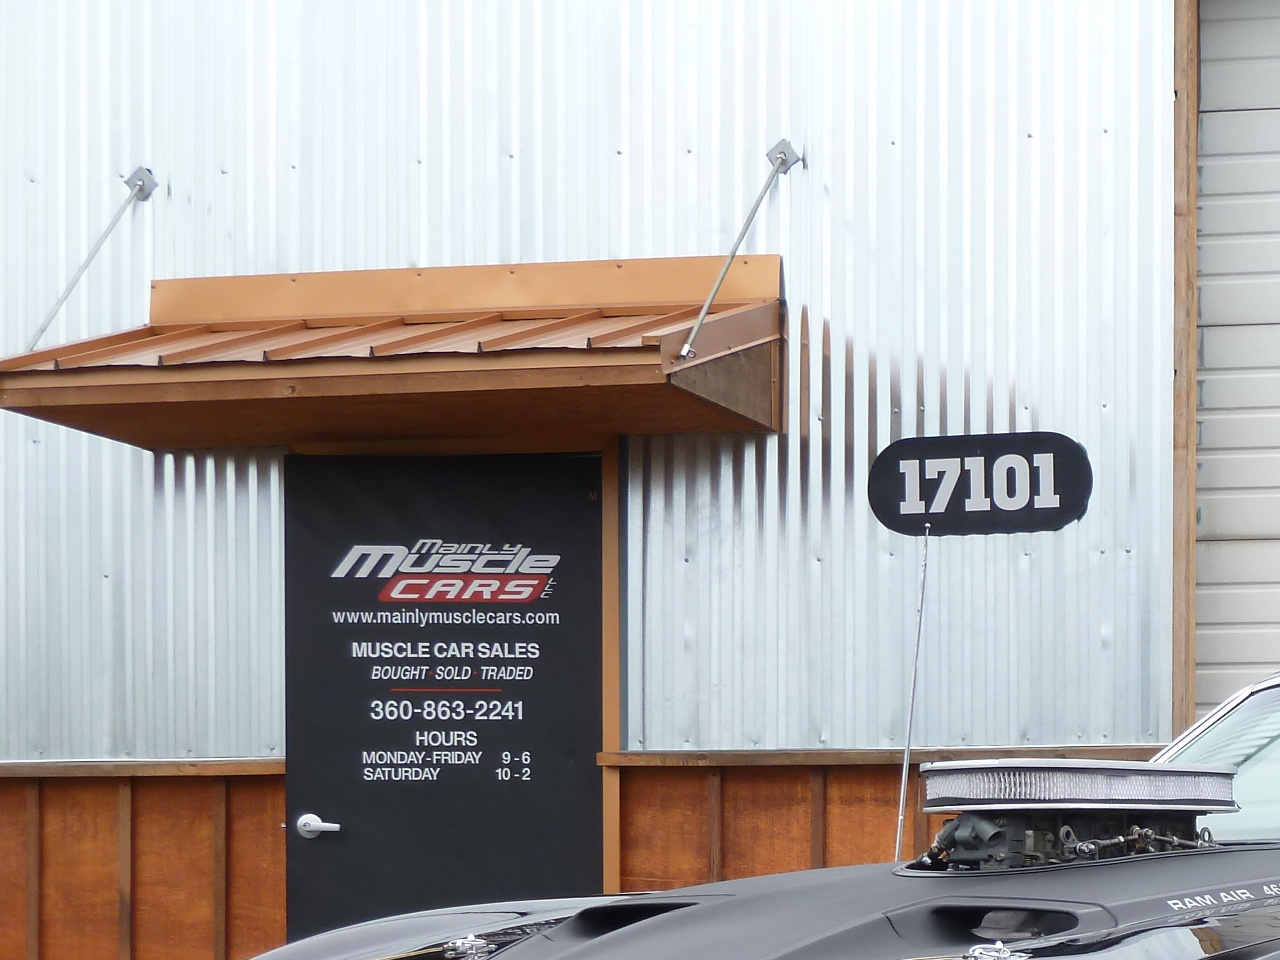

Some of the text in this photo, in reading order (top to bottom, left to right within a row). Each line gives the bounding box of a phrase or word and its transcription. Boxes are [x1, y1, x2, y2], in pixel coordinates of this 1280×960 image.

[899, 453, 1060, 514] 17101
[390, 579, 540, 599] CARS
[332, 608, 560, 627] www.mainlymusclecars.com
[351, 642, 540, 659] MUSCLE CAR SALES
[371, 665, 534, 680] BOUGHT SOLD TRADED
[370, 700, 523, 720] 360-863-2241
[415, 731, 478, 747] HOURS
[363, 767, 440, 781] SATURDAY
[1166, 894, 1217, 911] RAM
[1219, 889, 1255, 903] AIR
